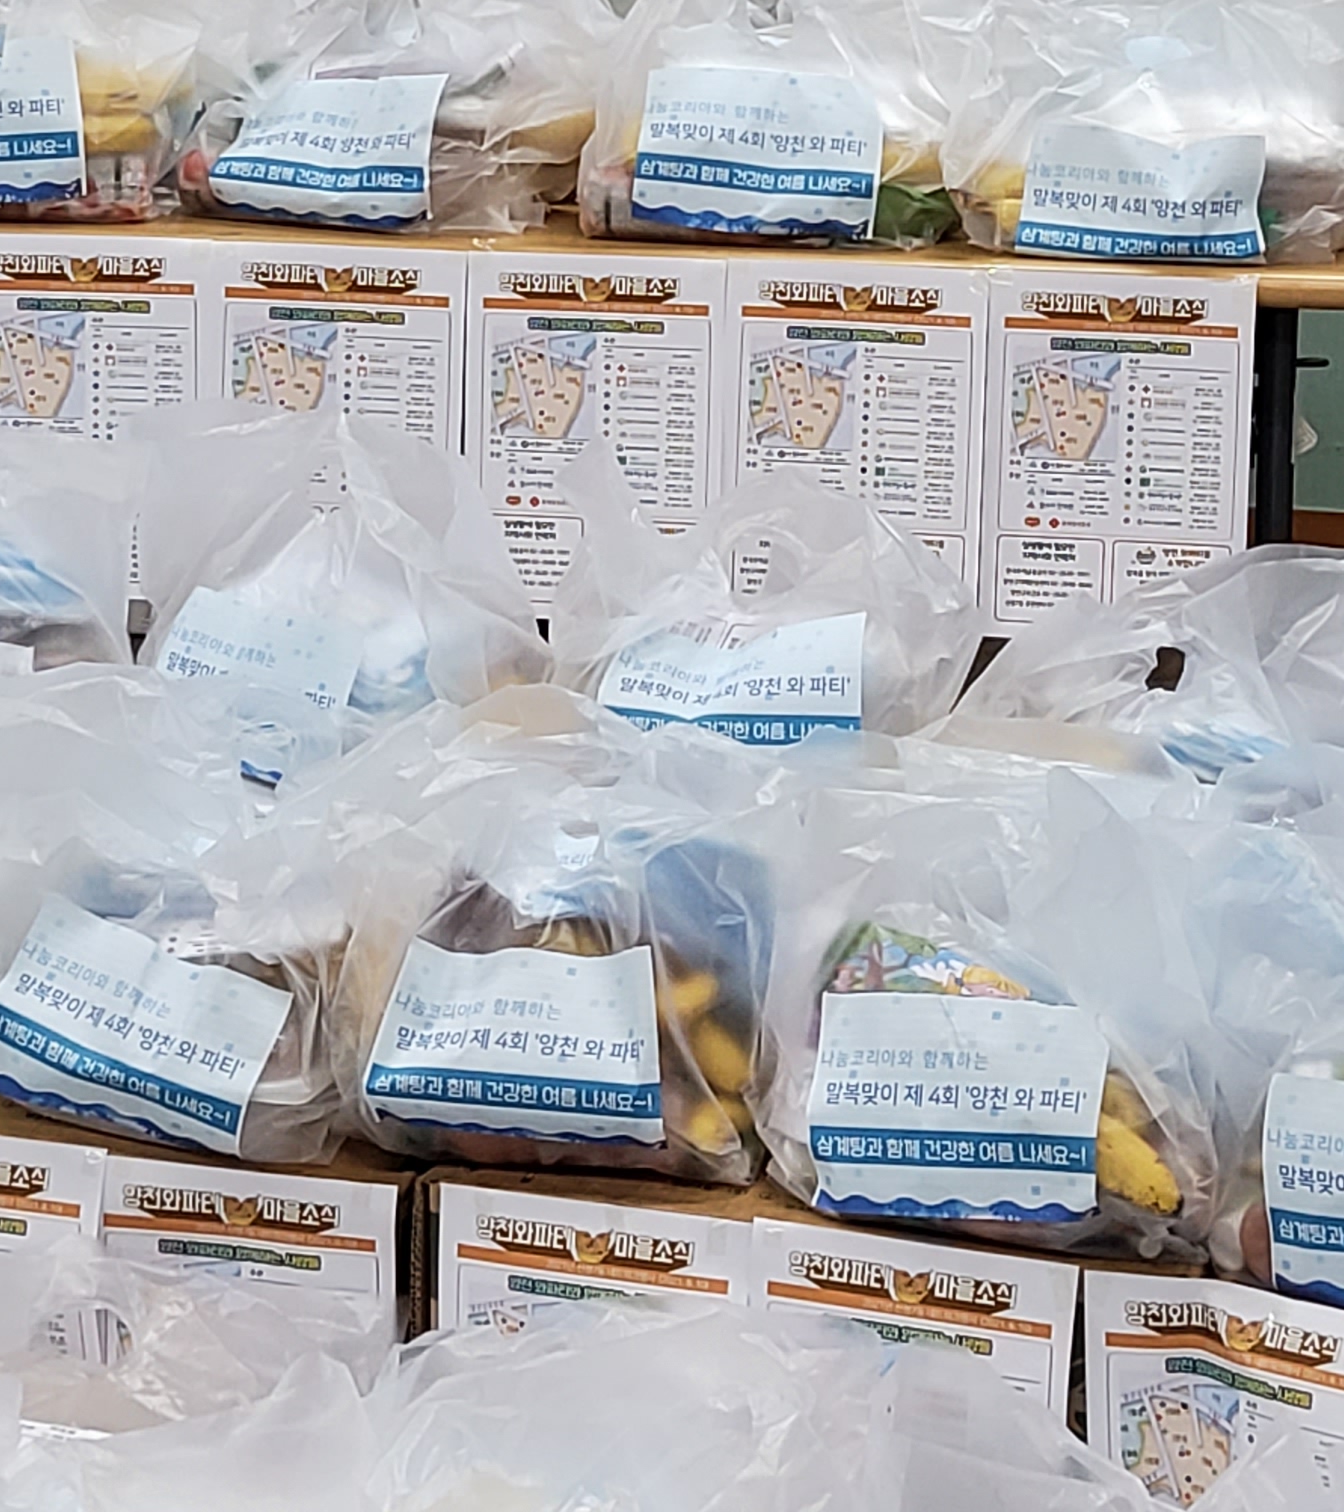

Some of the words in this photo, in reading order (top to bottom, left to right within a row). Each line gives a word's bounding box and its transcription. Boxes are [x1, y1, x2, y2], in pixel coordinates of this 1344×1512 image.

[7, 100, 24, 117] 와
[650, 121, 714, 143] 말복맞이
[718, 127, 735, 145] 제
[738, 130, 766, 148] 4회
[808, 136, 826, 155] 와
[395, 1026, 469, 1051] 말복맞이
[470, 1028, 491, 1049] 제
[494, 1030, 528, 1053] 4회
[584, 1039, 606, 1060] 와
[825, 1082, 899, 1107] 말복맞이
[904, 1083, 923, 1107] 제
[928, 1085, 959, 1108] 4회
[964, 1086, 1009, 1110] '양천
[1014, 1088, 1035, 1111] 와
[1039, 1090, 1087, 1113] 파티'
[817, 1135, 883, 1159] 삼계탕과
[886, 1138, 920, 1159] 함께
[922, 1139, 975, 1163] 건강한
[978, 1141, 1014, 1163] 여름
[1278, 1218, 1344, 1245] 삼계탕과
[933, 1272, 1017, 1309] 마을소식
